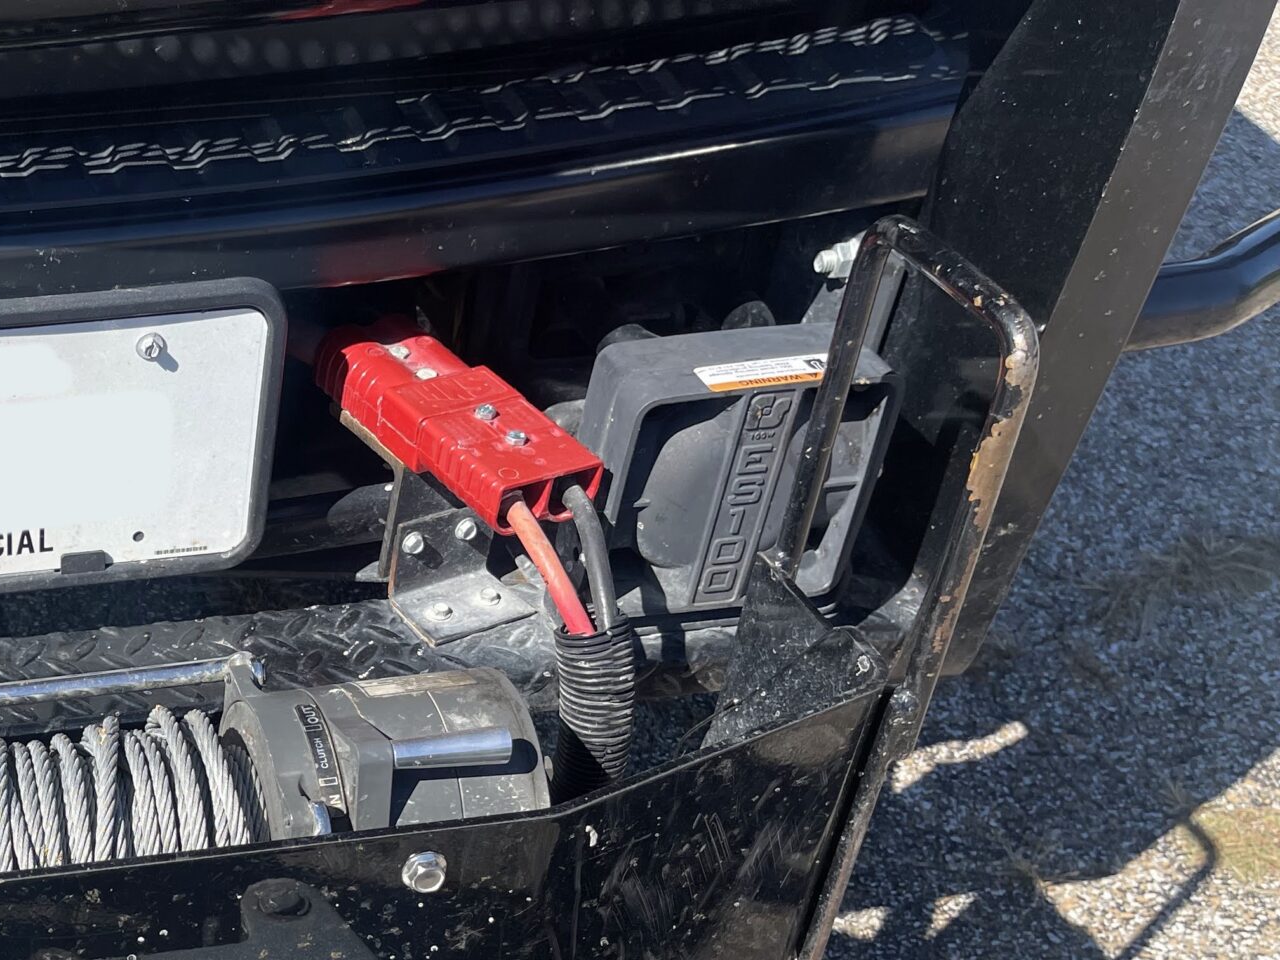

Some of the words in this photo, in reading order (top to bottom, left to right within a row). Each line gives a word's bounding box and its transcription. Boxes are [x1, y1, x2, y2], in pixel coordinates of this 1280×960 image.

[738, 374, 801, 386] WARNING
[301, 706, 319, 724] OUT
[314, 737, 328, 769] CLUTCH
